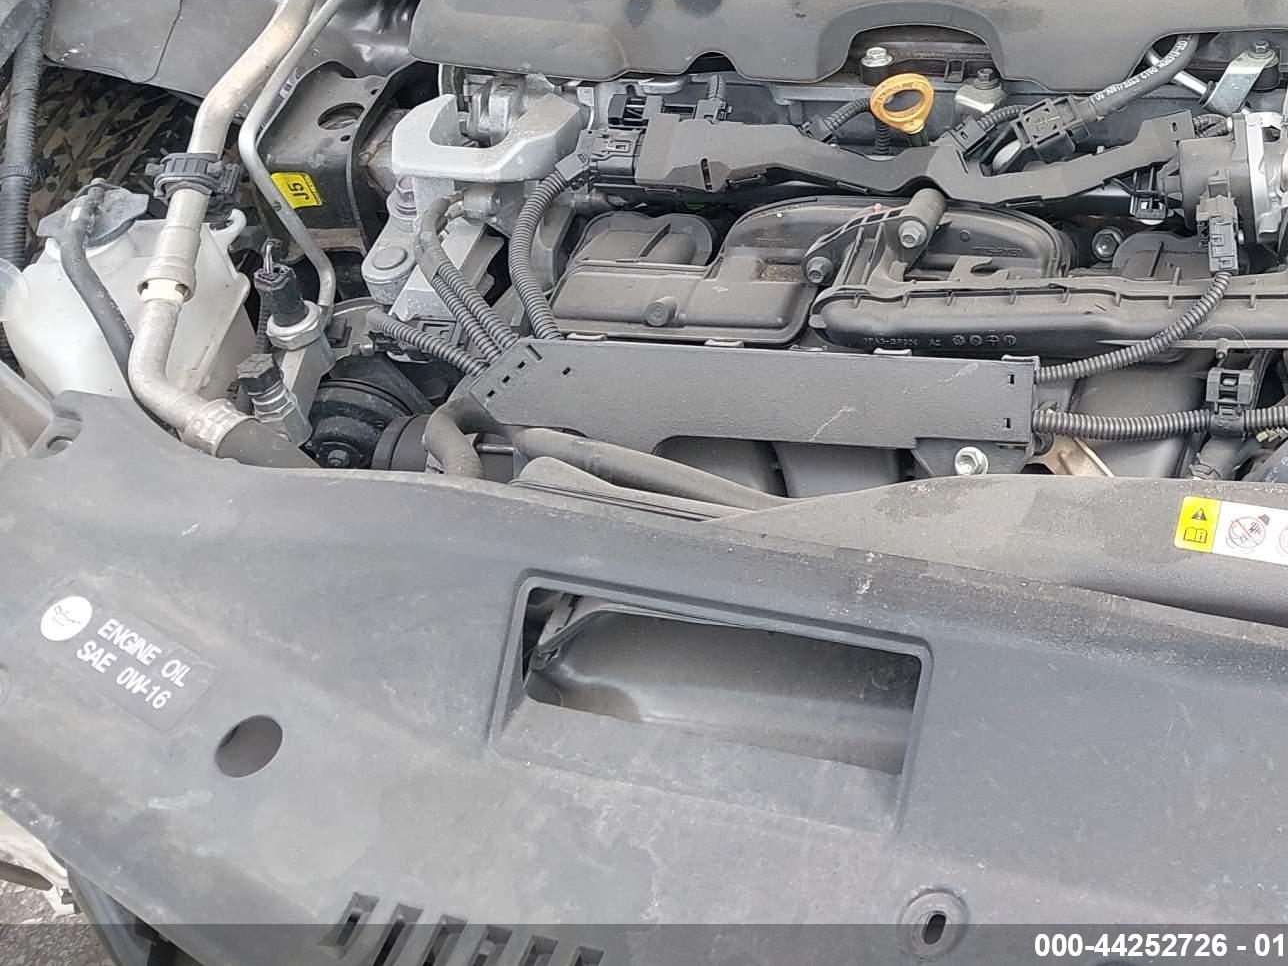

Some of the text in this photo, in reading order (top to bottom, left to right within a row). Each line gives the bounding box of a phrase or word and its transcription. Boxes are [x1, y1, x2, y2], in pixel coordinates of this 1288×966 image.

[77, 640, 172, 709] SAE 0W-16
[98, 619, 191, 687] ENGINE OIL
